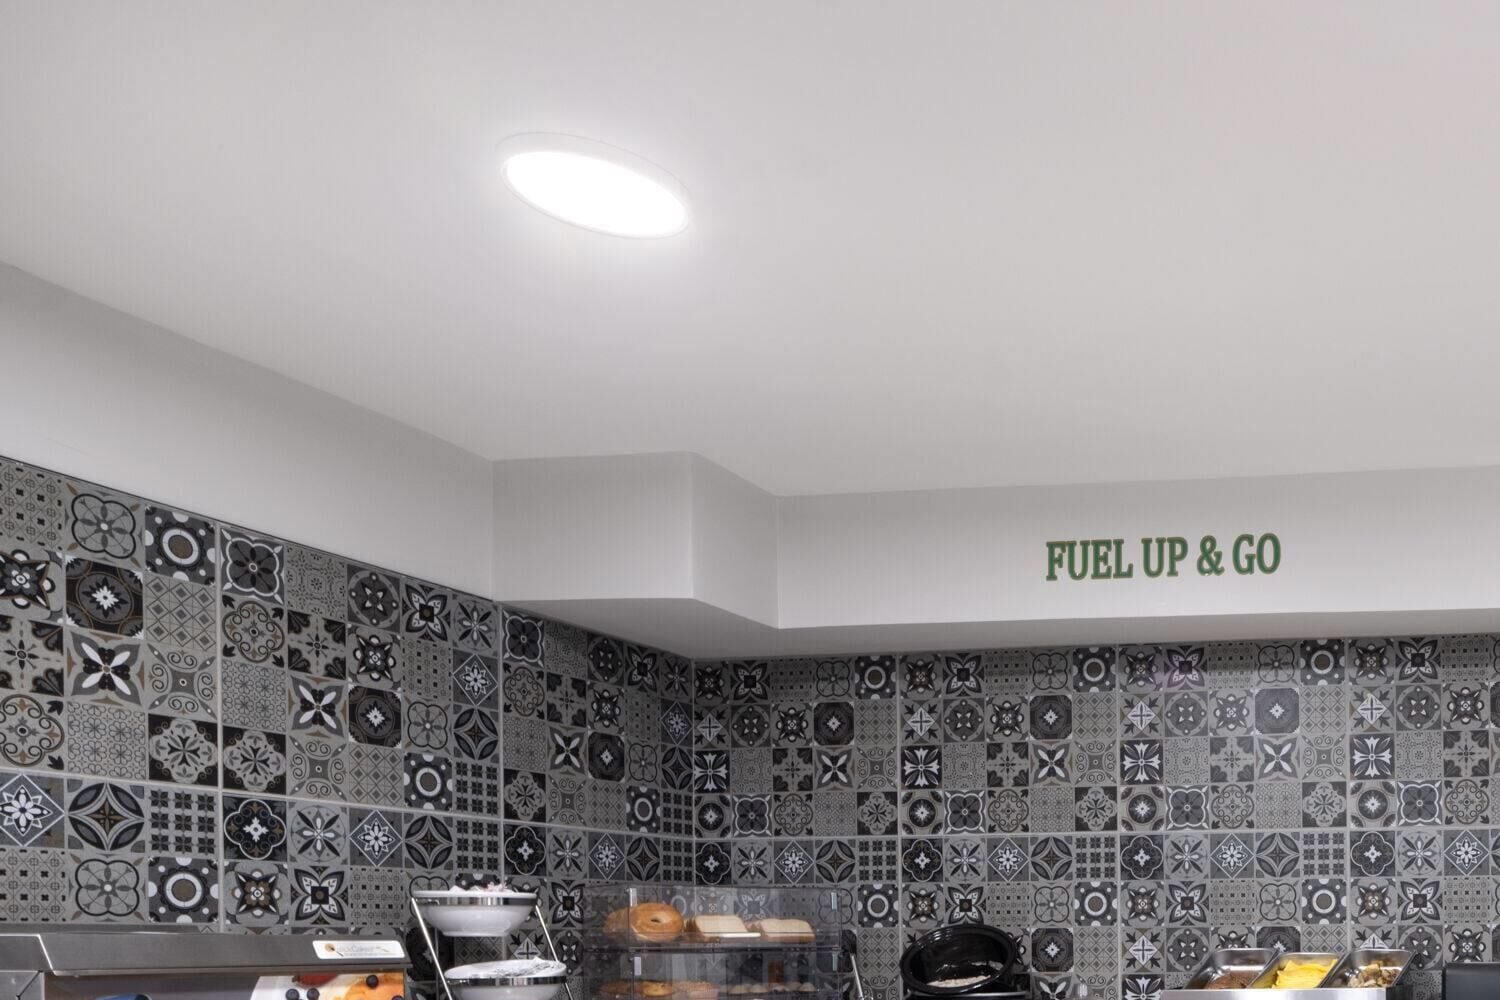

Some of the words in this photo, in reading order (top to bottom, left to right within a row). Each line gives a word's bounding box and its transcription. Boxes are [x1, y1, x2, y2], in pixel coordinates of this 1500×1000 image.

[1046, 538, 1133, 581] FUEL
[1141, 536, 1188, 578] UP
[1196, 534, 1225, 577] &
[1232, 532, 1282, 575] GO
